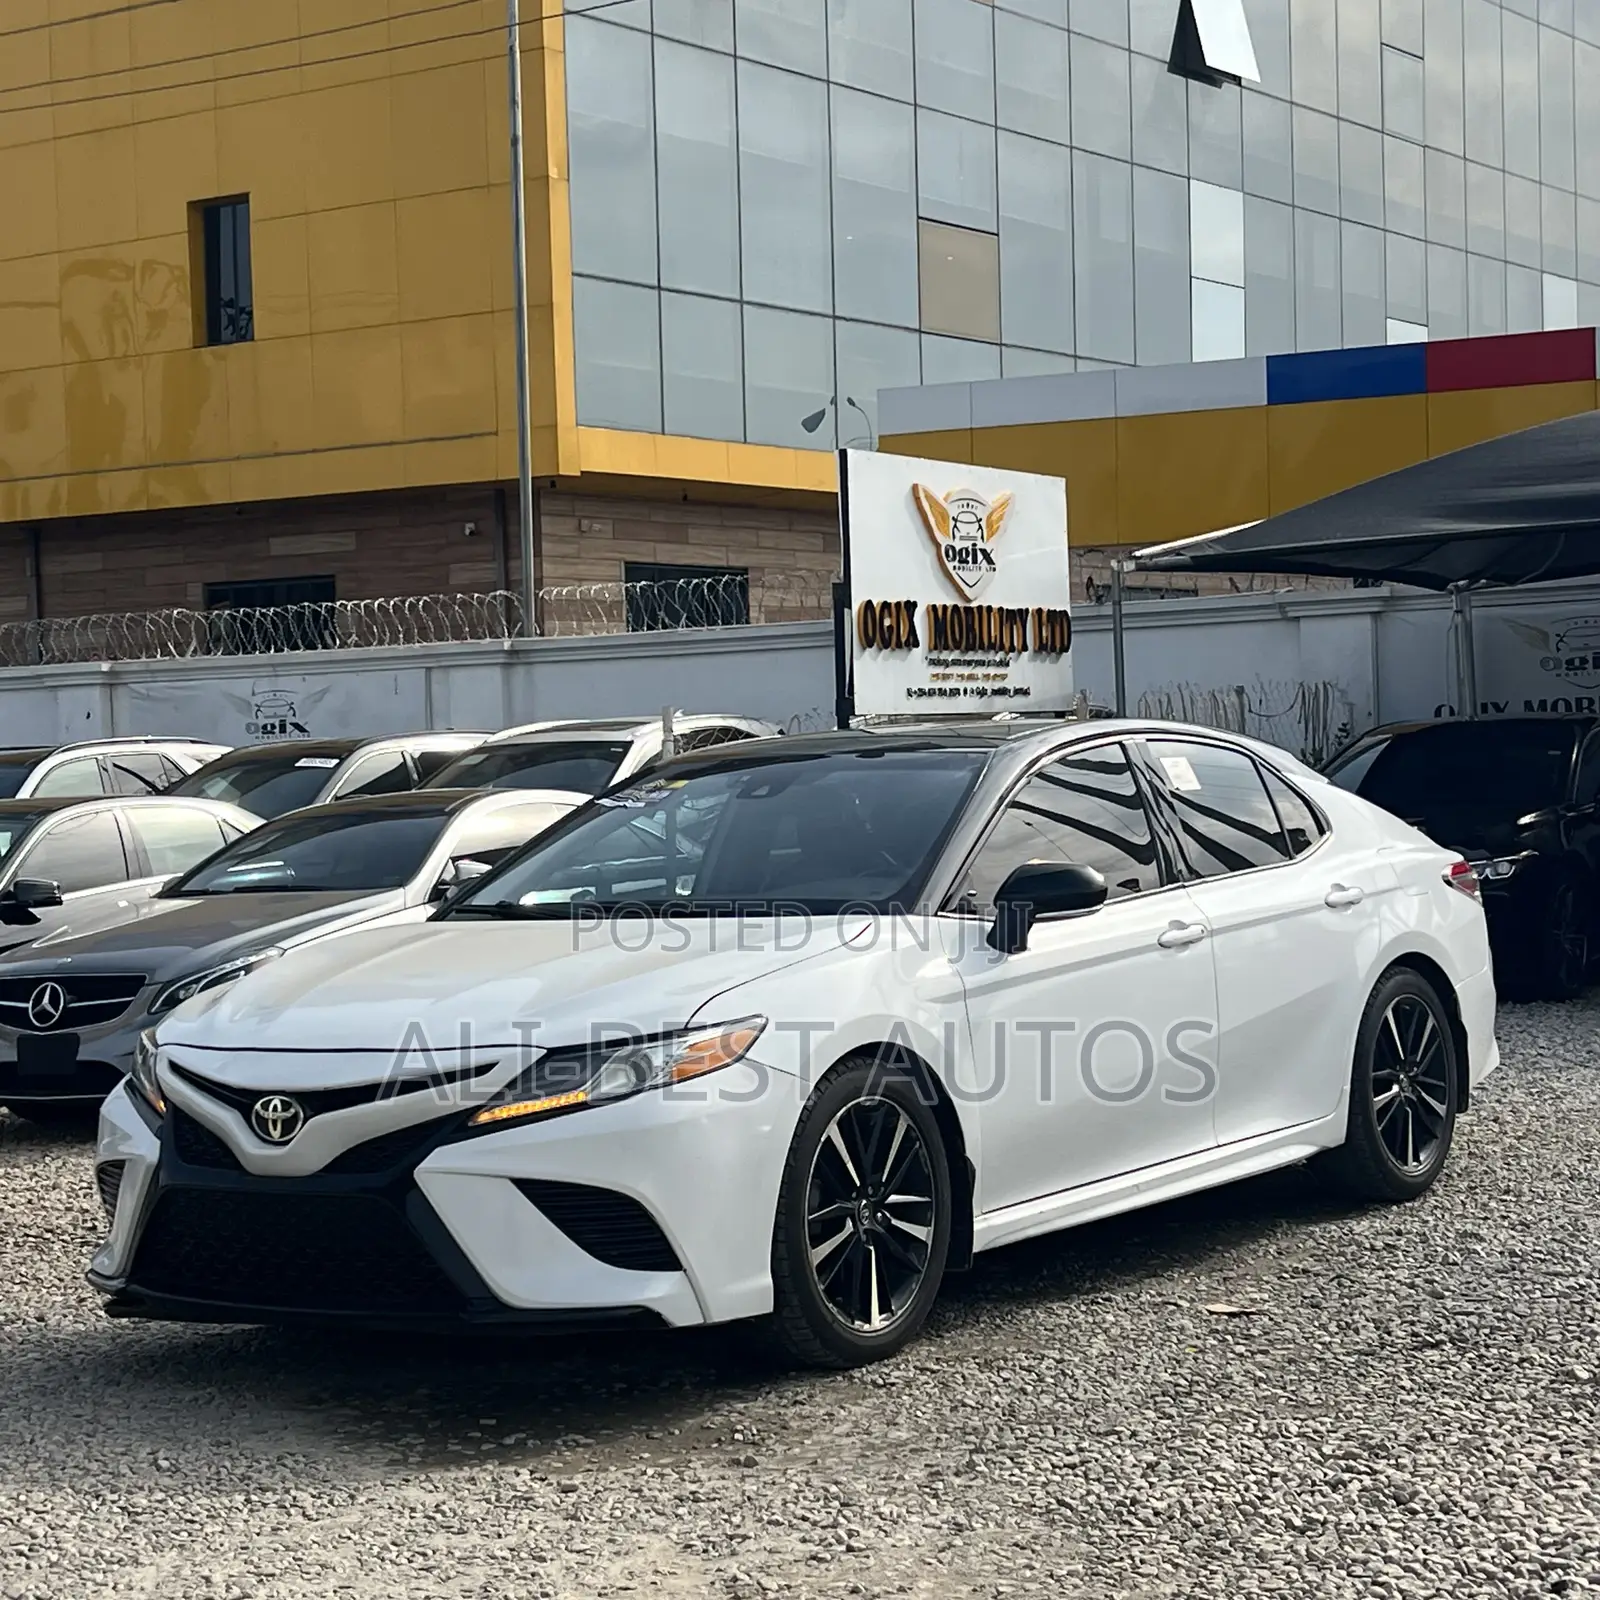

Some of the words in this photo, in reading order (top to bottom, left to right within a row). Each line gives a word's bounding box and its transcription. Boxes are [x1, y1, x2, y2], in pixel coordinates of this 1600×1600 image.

[857, 599, 920, 649] OGIX
[927, 603, 1029, 653] MOBILITY
[1031, 607, 1072, 653] LTD
